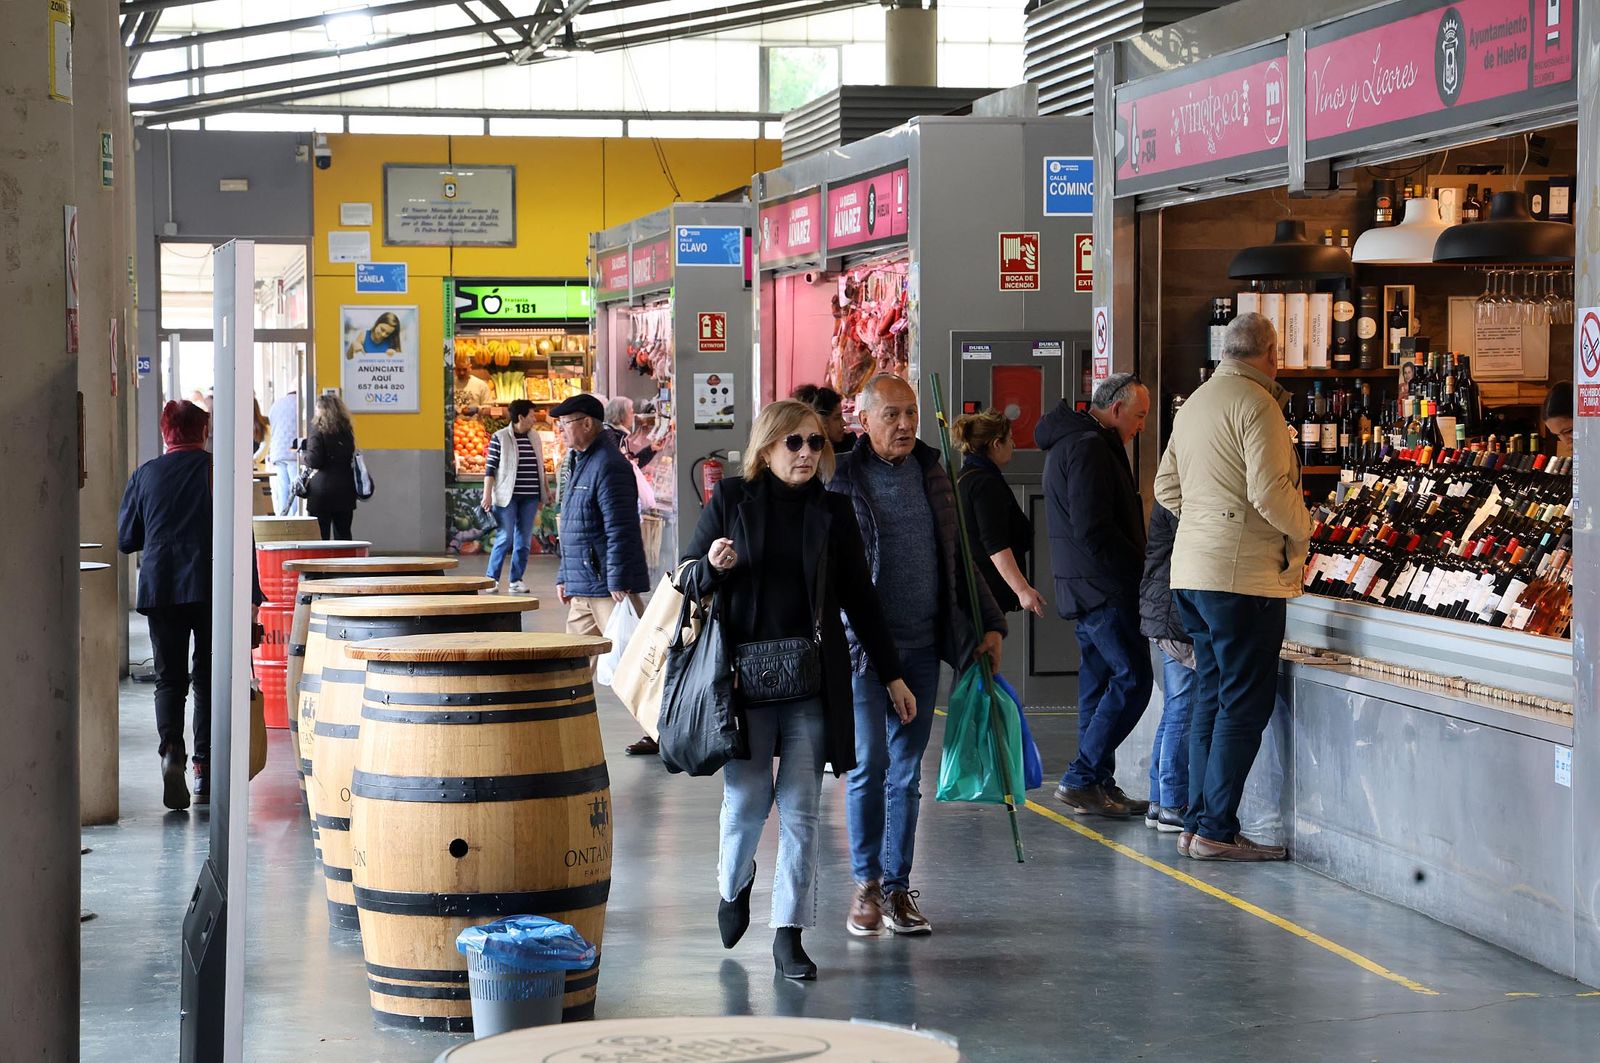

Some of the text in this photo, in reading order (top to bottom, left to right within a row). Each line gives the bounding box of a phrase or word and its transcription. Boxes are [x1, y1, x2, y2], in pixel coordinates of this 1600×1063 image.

[1469, 14, 1528, 48] Ayuntamiento
[1483, 49, 1495, 70] de
[1496, 42, 1528, 68] Huelva
[1312, 43, 1418, 128] Vinos y Licores
[1179, 85, 1242, 134] vinoteca
[788, 217, 811, 247] ÁLVAREZ
[834, 205, 861, 238] ÁLVAREZ
[680, 242, 708, 253] CLAVO
[358, 275, 385, 283] CANELA
[515, 303, 537, 314] 181
[358, 364, 404, 372] ANÚNCIATE
[371, 374, 392, 382] AQUÍ
